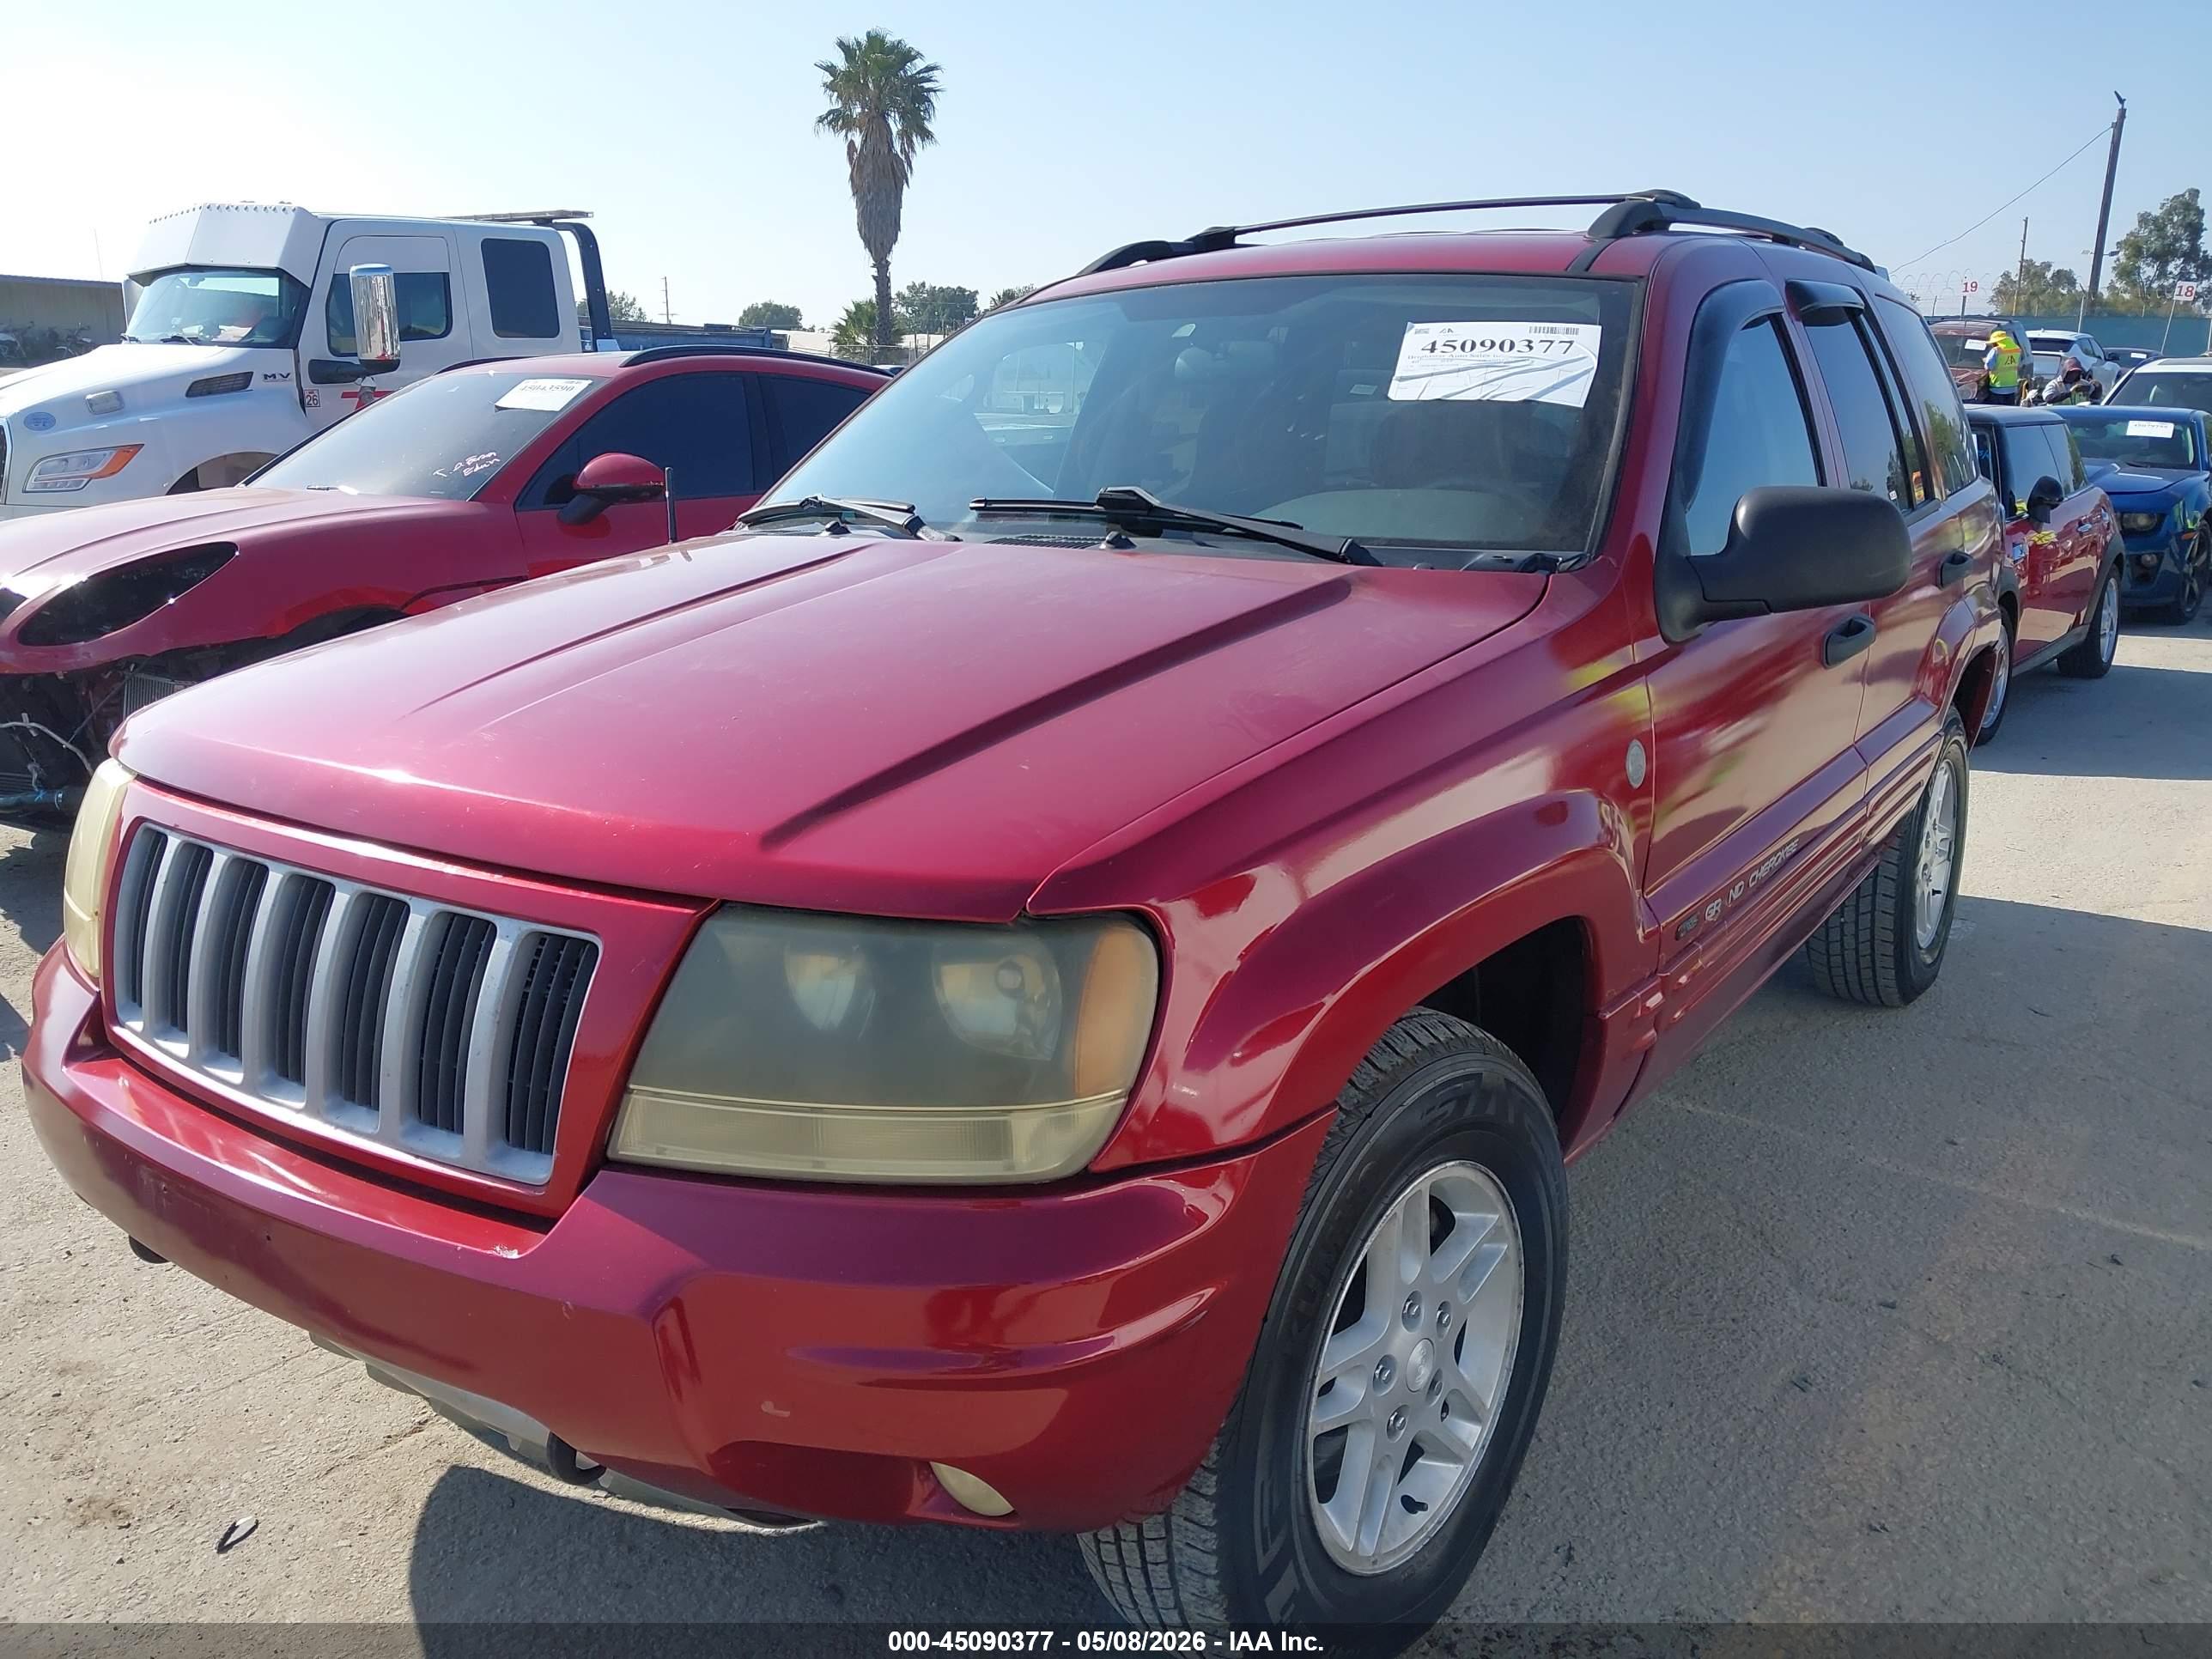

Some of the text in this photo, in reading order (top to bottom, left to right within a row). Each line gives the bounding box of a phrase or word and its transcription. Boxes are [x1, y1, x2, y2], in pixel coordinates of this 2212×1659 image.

[1961, 281, 1978, 293] 19
[2175, 285, 2195, 297] 18
[1421, 338, 1575, 355] 45090377
[263, 372, 291, 380] MV
[306, 394, 319, 406] 26
[1748, 838, 1800, 888] CHEROKEE
